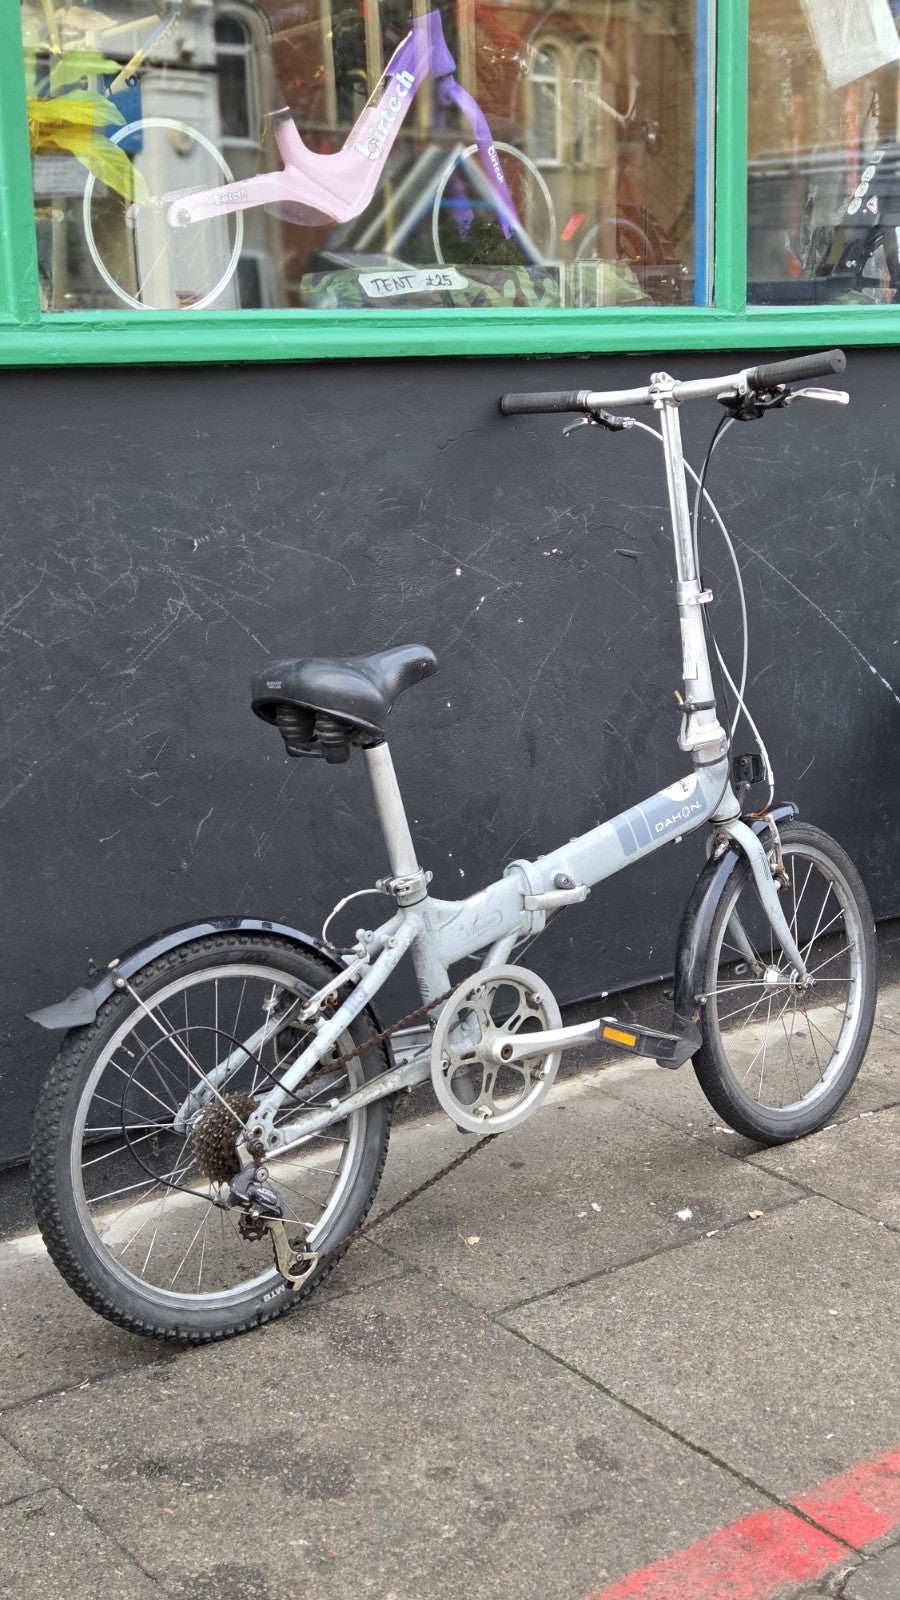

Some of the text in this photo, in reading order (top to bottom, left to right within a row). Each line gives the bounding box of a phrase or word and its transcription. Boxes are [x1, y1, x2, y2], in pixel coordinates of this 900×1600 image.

[355, 71, 416, 160] birtech
[370, 274, 453, 292] TENT £25
[655, 801, 702, 833] DAHON
[263, 1284, 286, 1303] MTB
